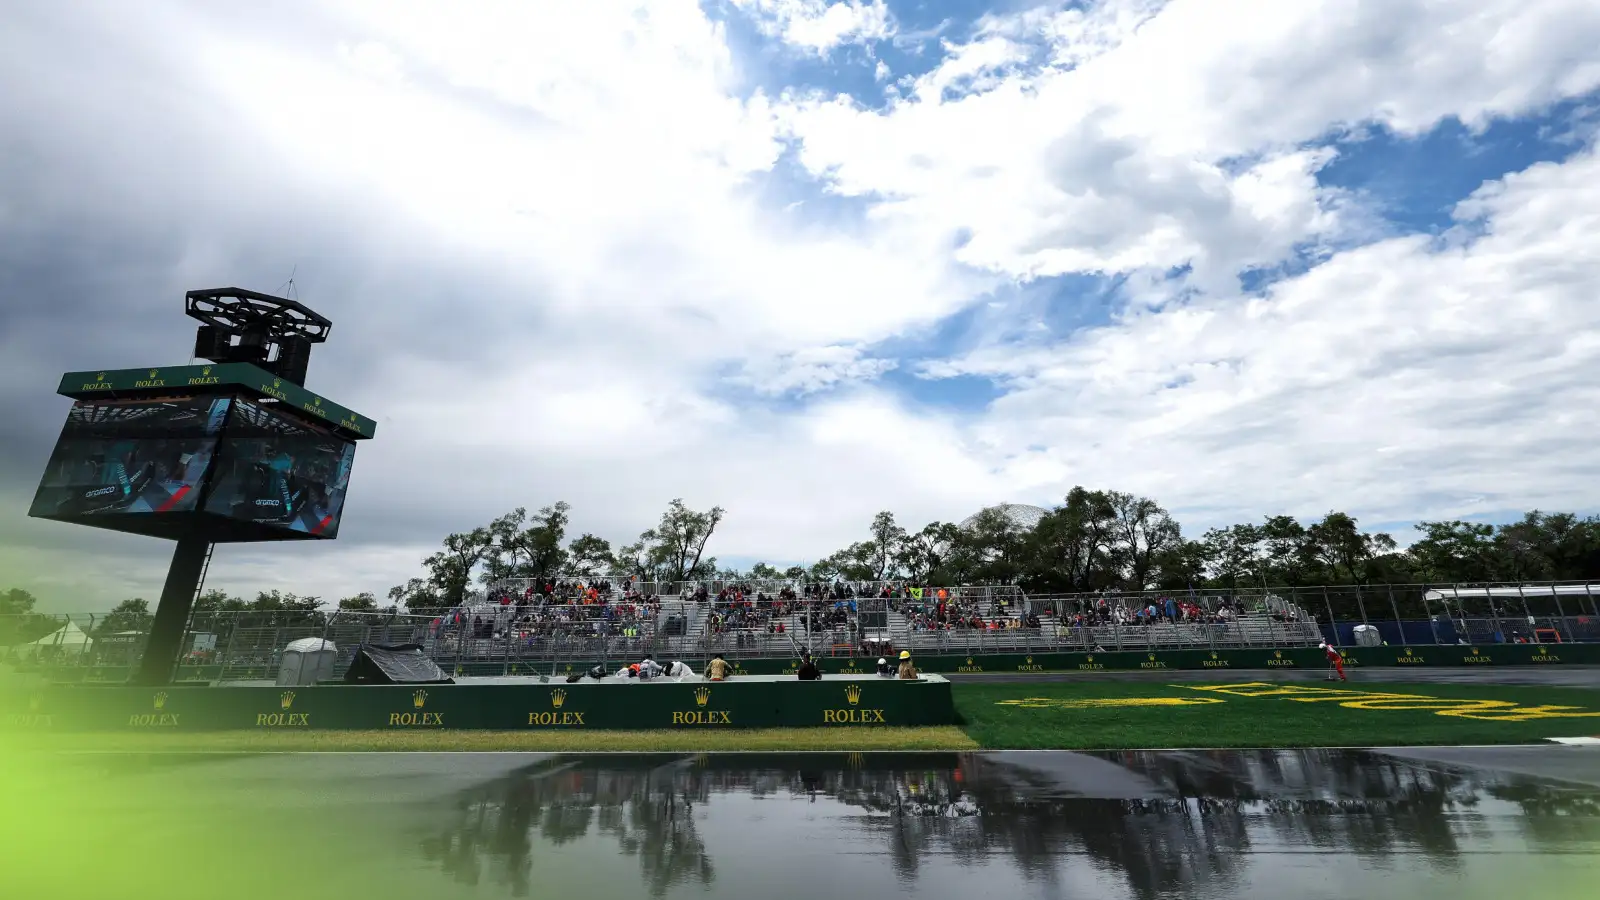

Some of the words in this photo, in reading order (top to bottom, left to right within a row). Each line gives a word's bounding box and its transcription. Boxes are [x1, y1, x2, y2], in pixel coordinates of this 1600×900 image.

[82, 382, 113, 391] ROLEX
[134, 379, 165, 388] ROLEX
[187, 376, 219, 385] ROLEX
[261, 384, 287, 401] ROLEX
[303, 402, 327, 418] ROLEX
[340, 419, 361, 433] ROLEX
[1397, 656, 1425, 664] ROLEX
[128, 713, 180, 727] ROLEX
[256, 713, 309, 726] ROLEX
[389, 712, 444, 726] ROLEX
[528, 711, 585, 725] ROLEX
[672, 710, 731, 724] ROLEX
[823, 708, 885, 723] ROLEX
